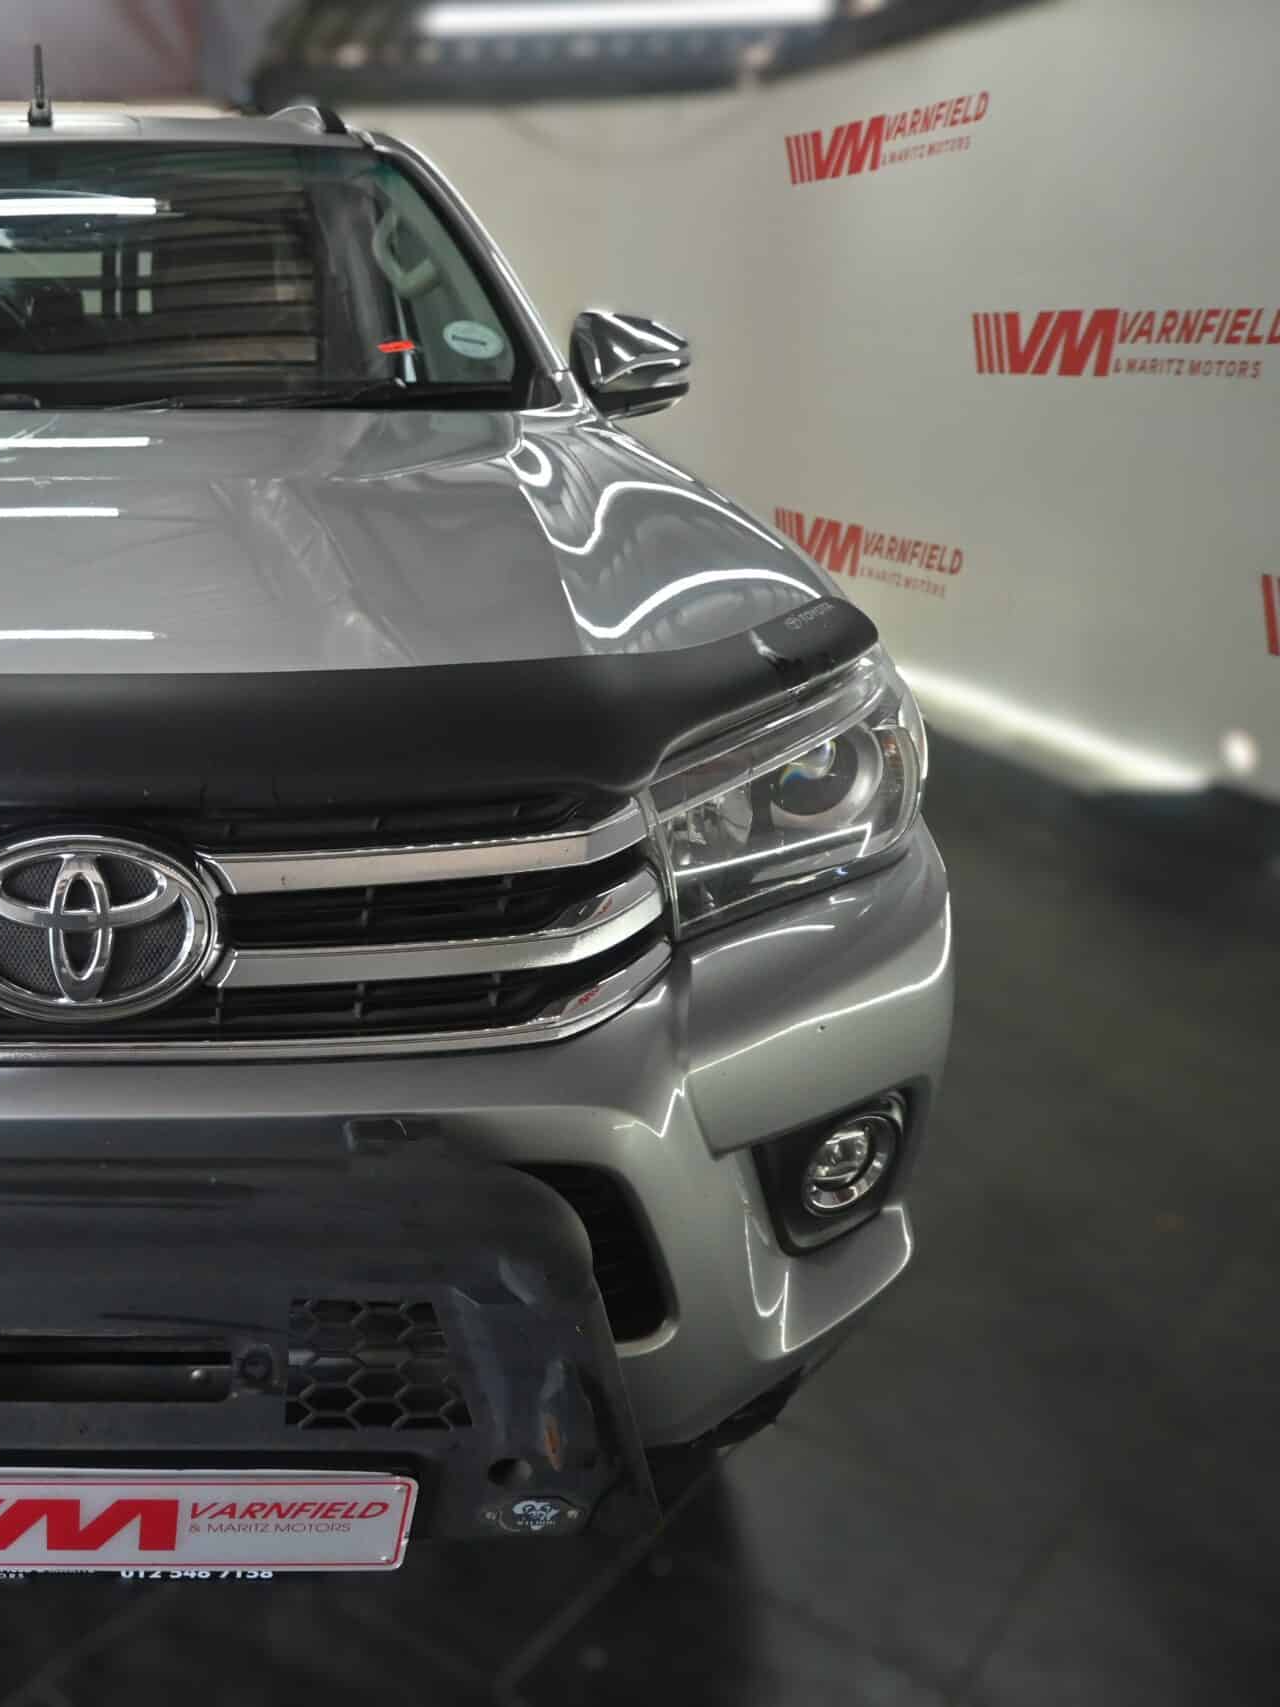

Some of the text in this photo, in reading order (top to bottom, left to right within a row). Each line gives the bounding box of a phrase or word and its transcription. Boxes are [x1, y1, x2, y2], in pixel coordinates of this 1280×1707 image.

[883, 91, 989, 142] VARNFIELD
[811, 115, 885, 181] VM
[1004, 308, 1119, 377] VM
[1188, 359, 1262, 379] MOTORS
[864, 530, 964, 575] VARNFIELD
[190, 1502, 389, 1520] VARNFIELD
[190, 1521, 352, 1534] & MARITZ MOTORS
